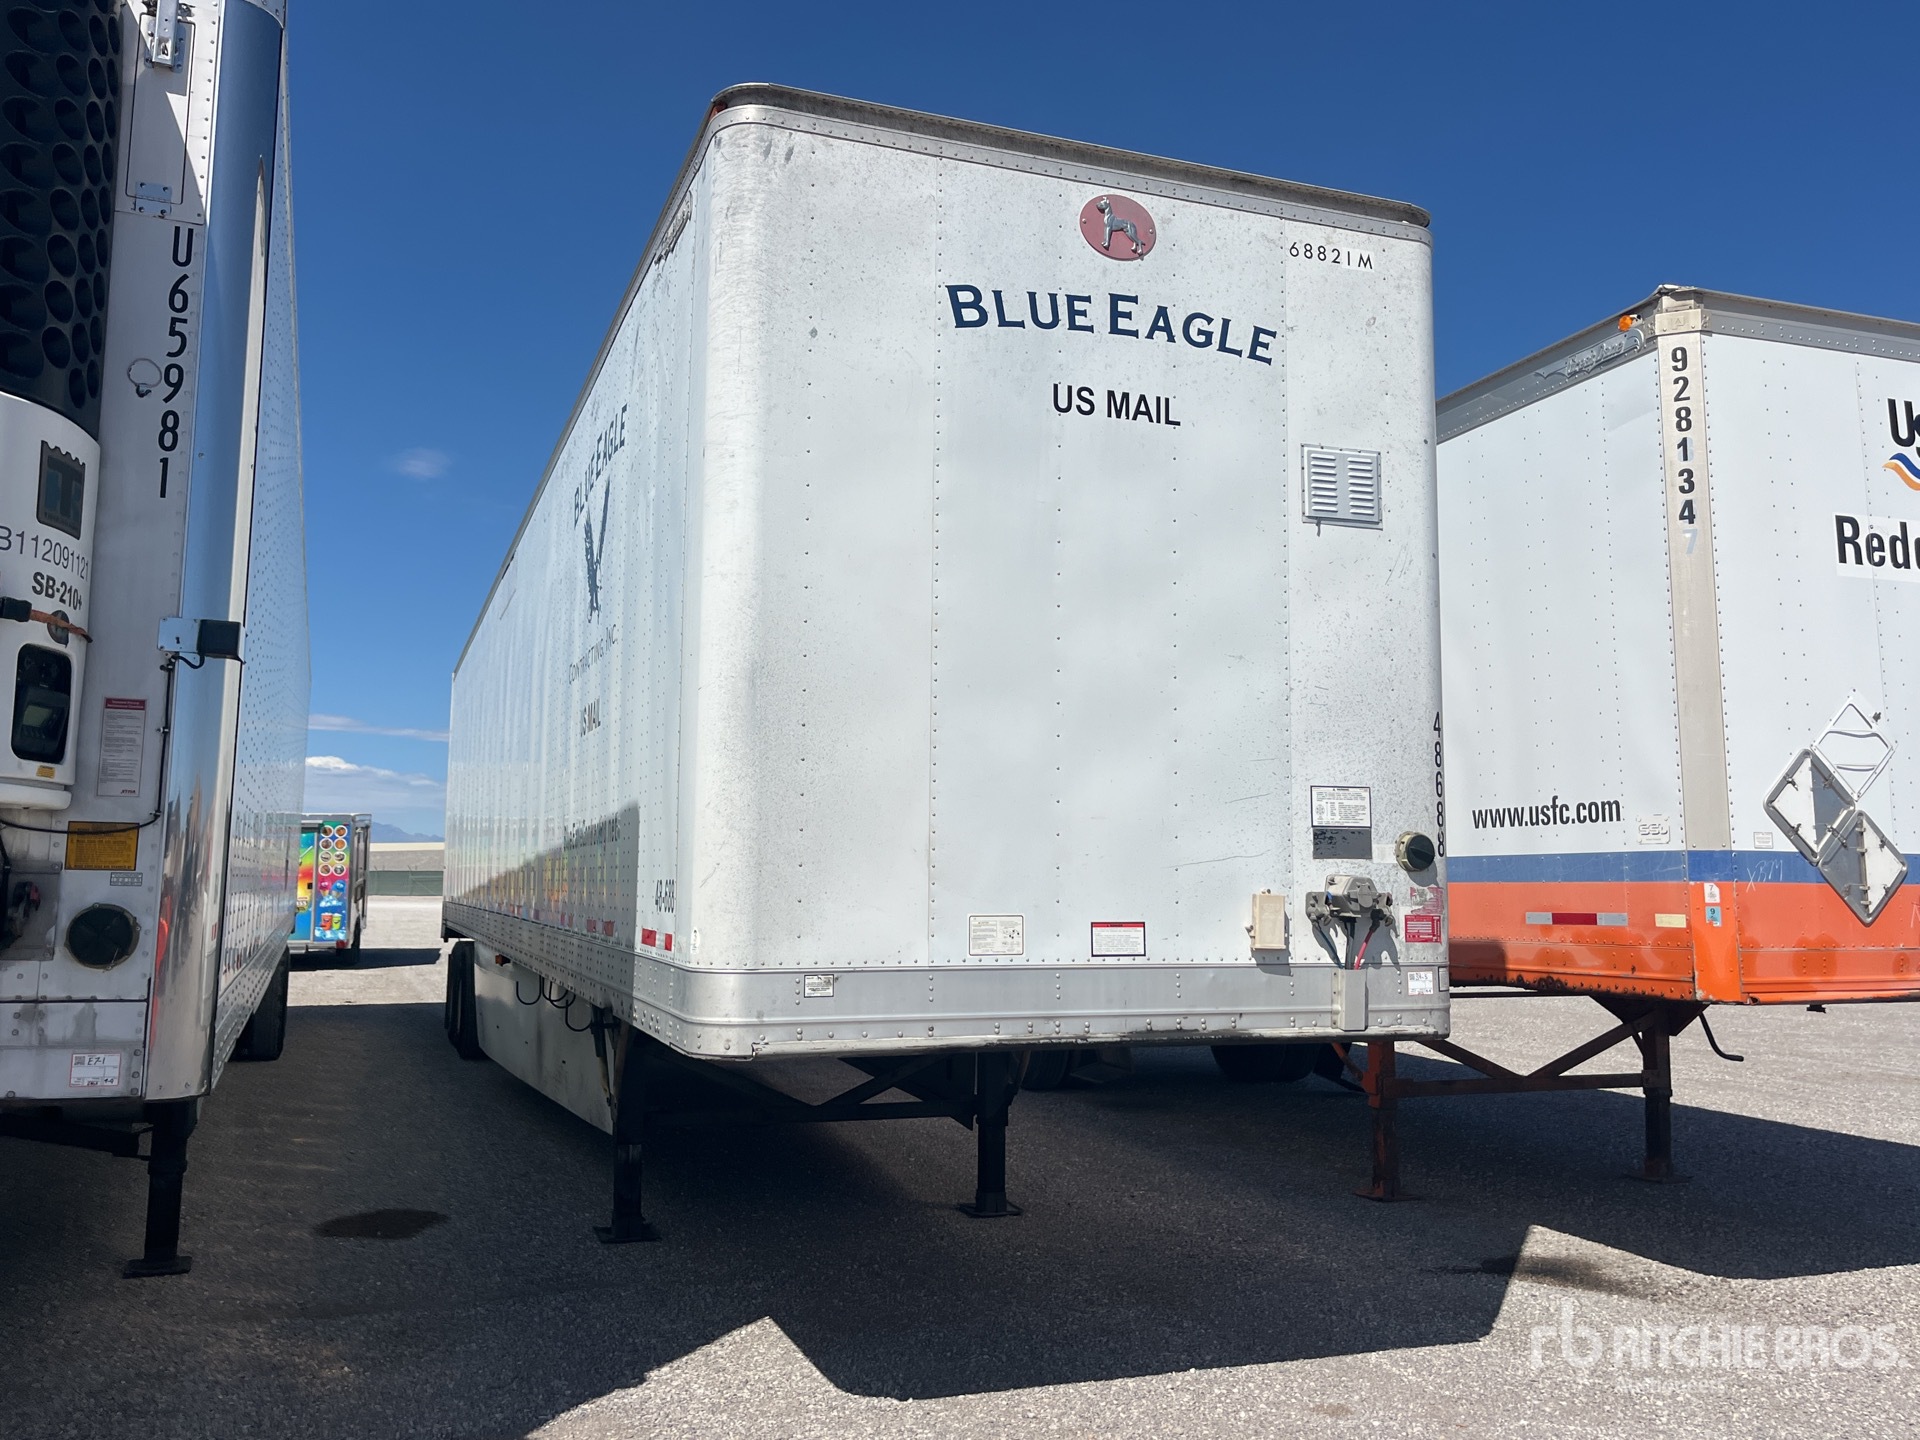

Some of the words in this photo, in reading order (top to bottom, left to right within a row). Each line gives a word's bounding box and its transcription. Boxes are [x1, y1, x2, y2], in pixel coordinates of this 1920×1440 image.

[1289, 242, 1373, 270] 68821M
[945, 284, 1094, 334] BLUE
[1108, 293, 1277, 366] EAGLE
[157, 226, 194, 498] U65981
[1053, 383, 1095, 416] US
[1106, 389, 1181, 426] MAIL
[1887, 398, 1920, 459] U
[574, 453, 595, 530] BLUE
[596, 403, 628, 480] EAGLE
[1835, 514, 1920, 569] Red
[1472, 795, 1621, 829] www.usfc.com
